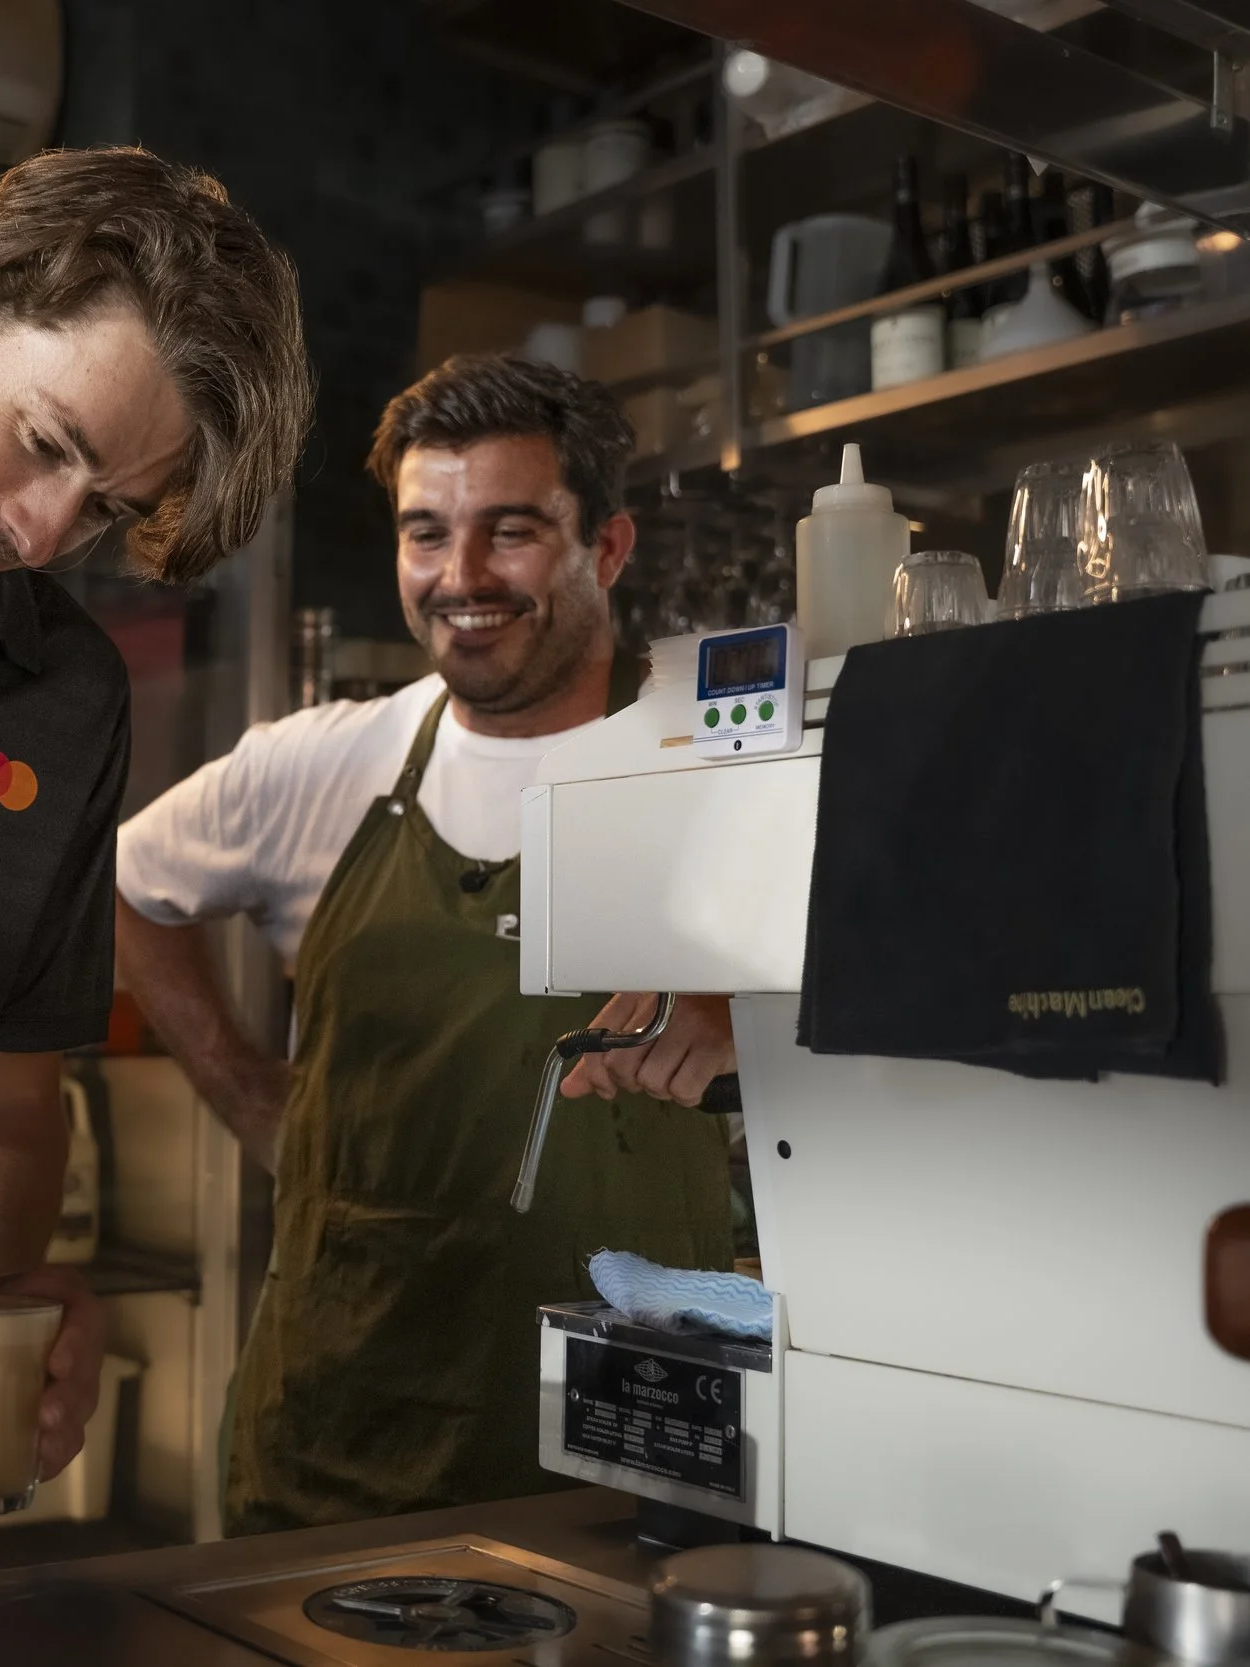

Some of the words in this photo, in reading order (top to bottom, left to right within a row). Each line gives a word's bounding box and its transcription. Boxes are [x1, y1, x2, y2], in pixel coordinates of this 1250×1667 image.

[707, 688, 726, 696] COUNT
[756, 681, 774, 690] TIMER
[622, 1378, 630, 1393] la
[632, 1383, 679, 1405] marzocco
[696, 1375, 722, 1404] CE
